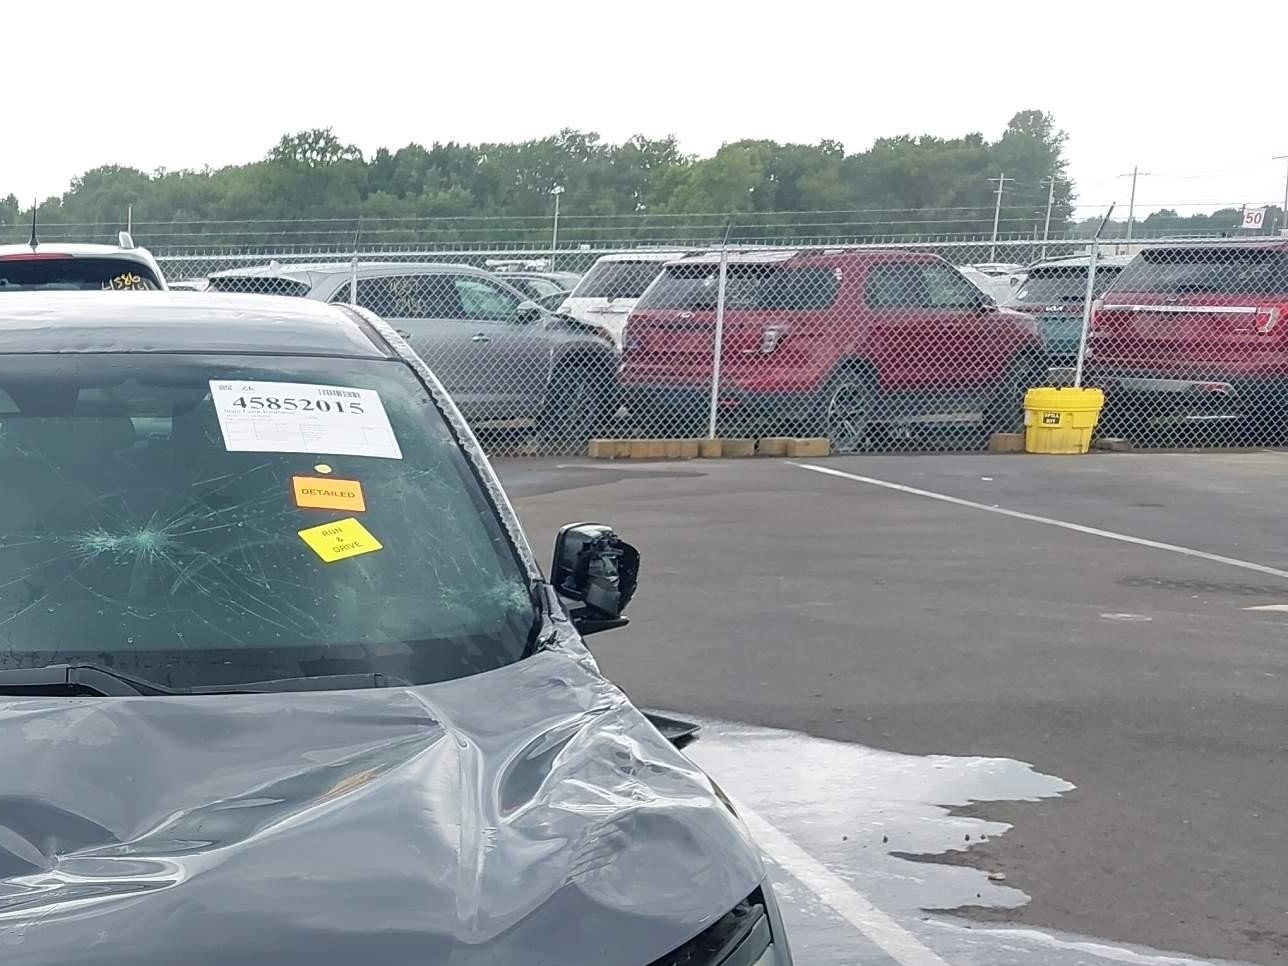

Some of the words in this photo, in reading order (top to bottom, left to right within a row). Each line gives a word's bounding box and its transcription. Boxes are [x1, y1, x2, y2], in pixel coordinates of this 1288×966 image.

[1245, 212, 1262, 224] 50
[232, 396, 365, 415] 45852015
[301, 488, 356, 498] DETAILED
[321, 527, 343, 537] RUN
[332, 541, 363, 553] DRIVE
